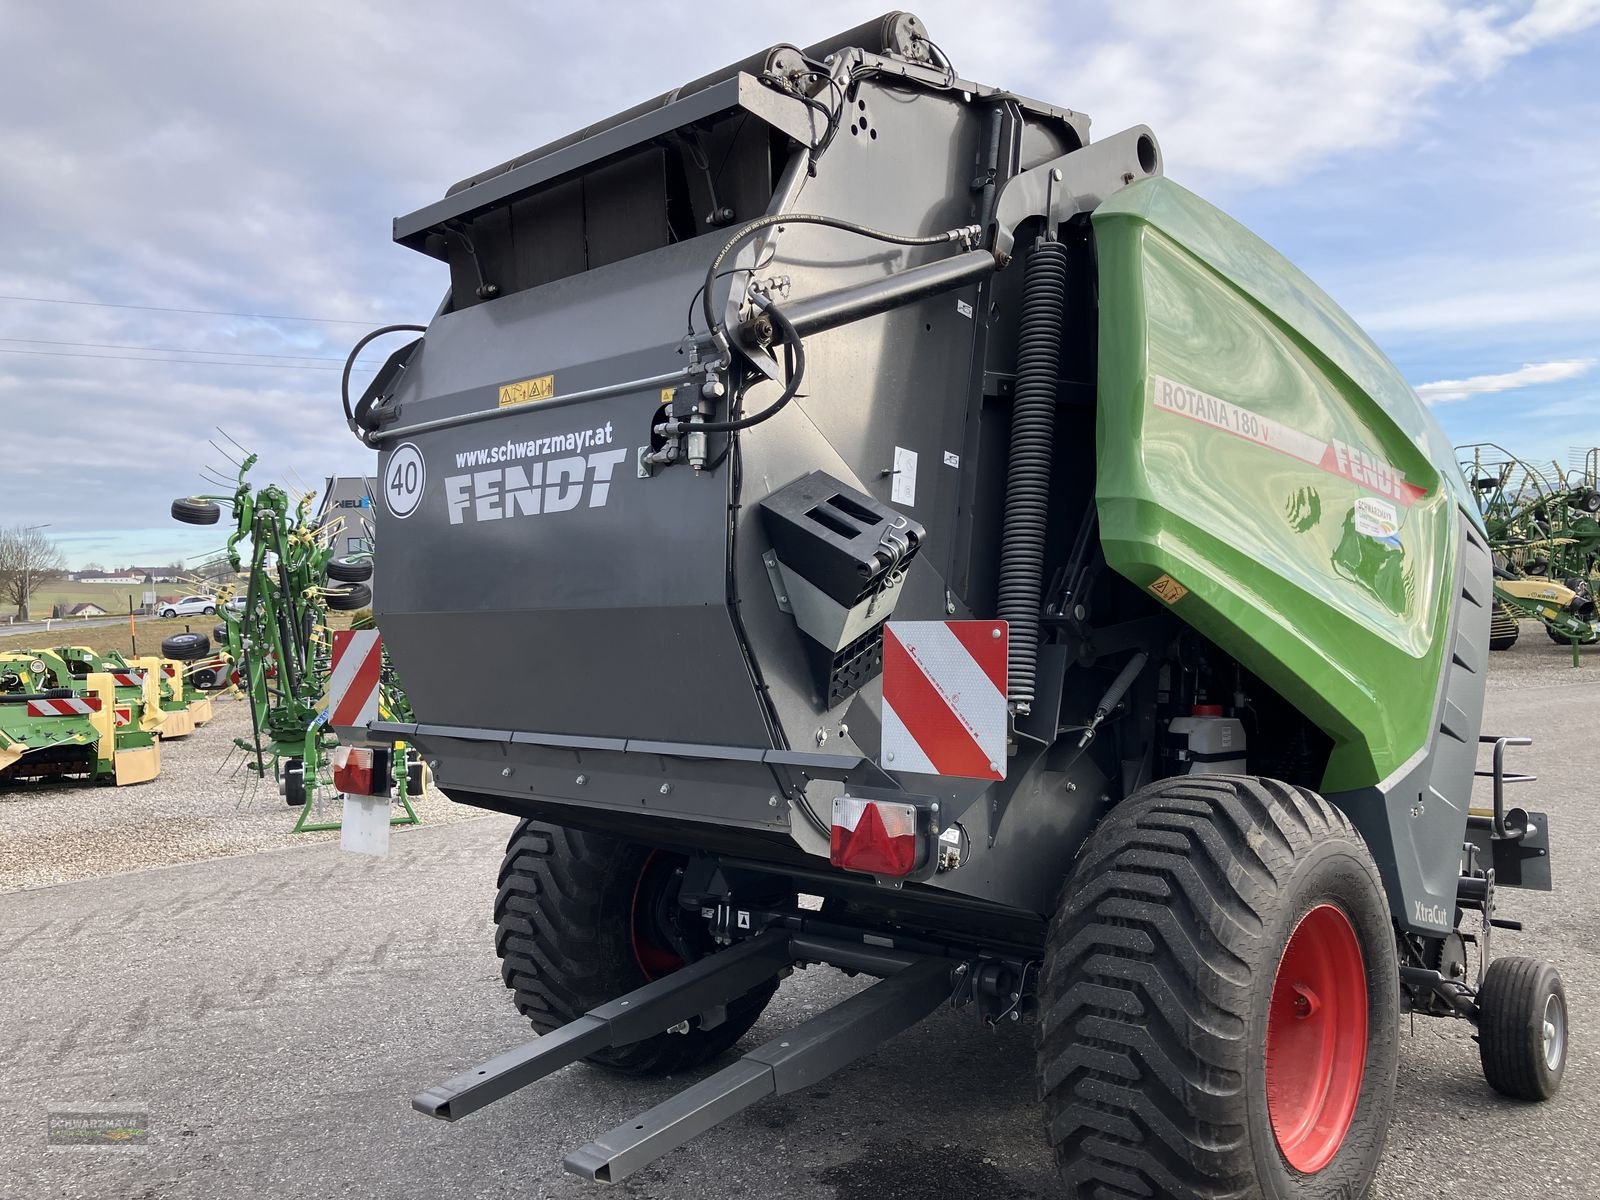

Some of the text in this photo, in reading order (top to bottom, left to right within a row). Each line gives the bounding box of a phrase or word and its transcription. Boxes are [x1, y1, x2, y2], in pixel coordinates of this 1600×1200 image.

[1162, 381, 1269, 442] ROTANA 180 V
[456, 420, 613, 469] www.schwarzmayr.at
[1332, 438, 1406, 500] FENDT
[390, 461, 417, 496] 40
[444, 448, 627, 525] FENDT
[1414, 900, 1448, 926] XtraCut
